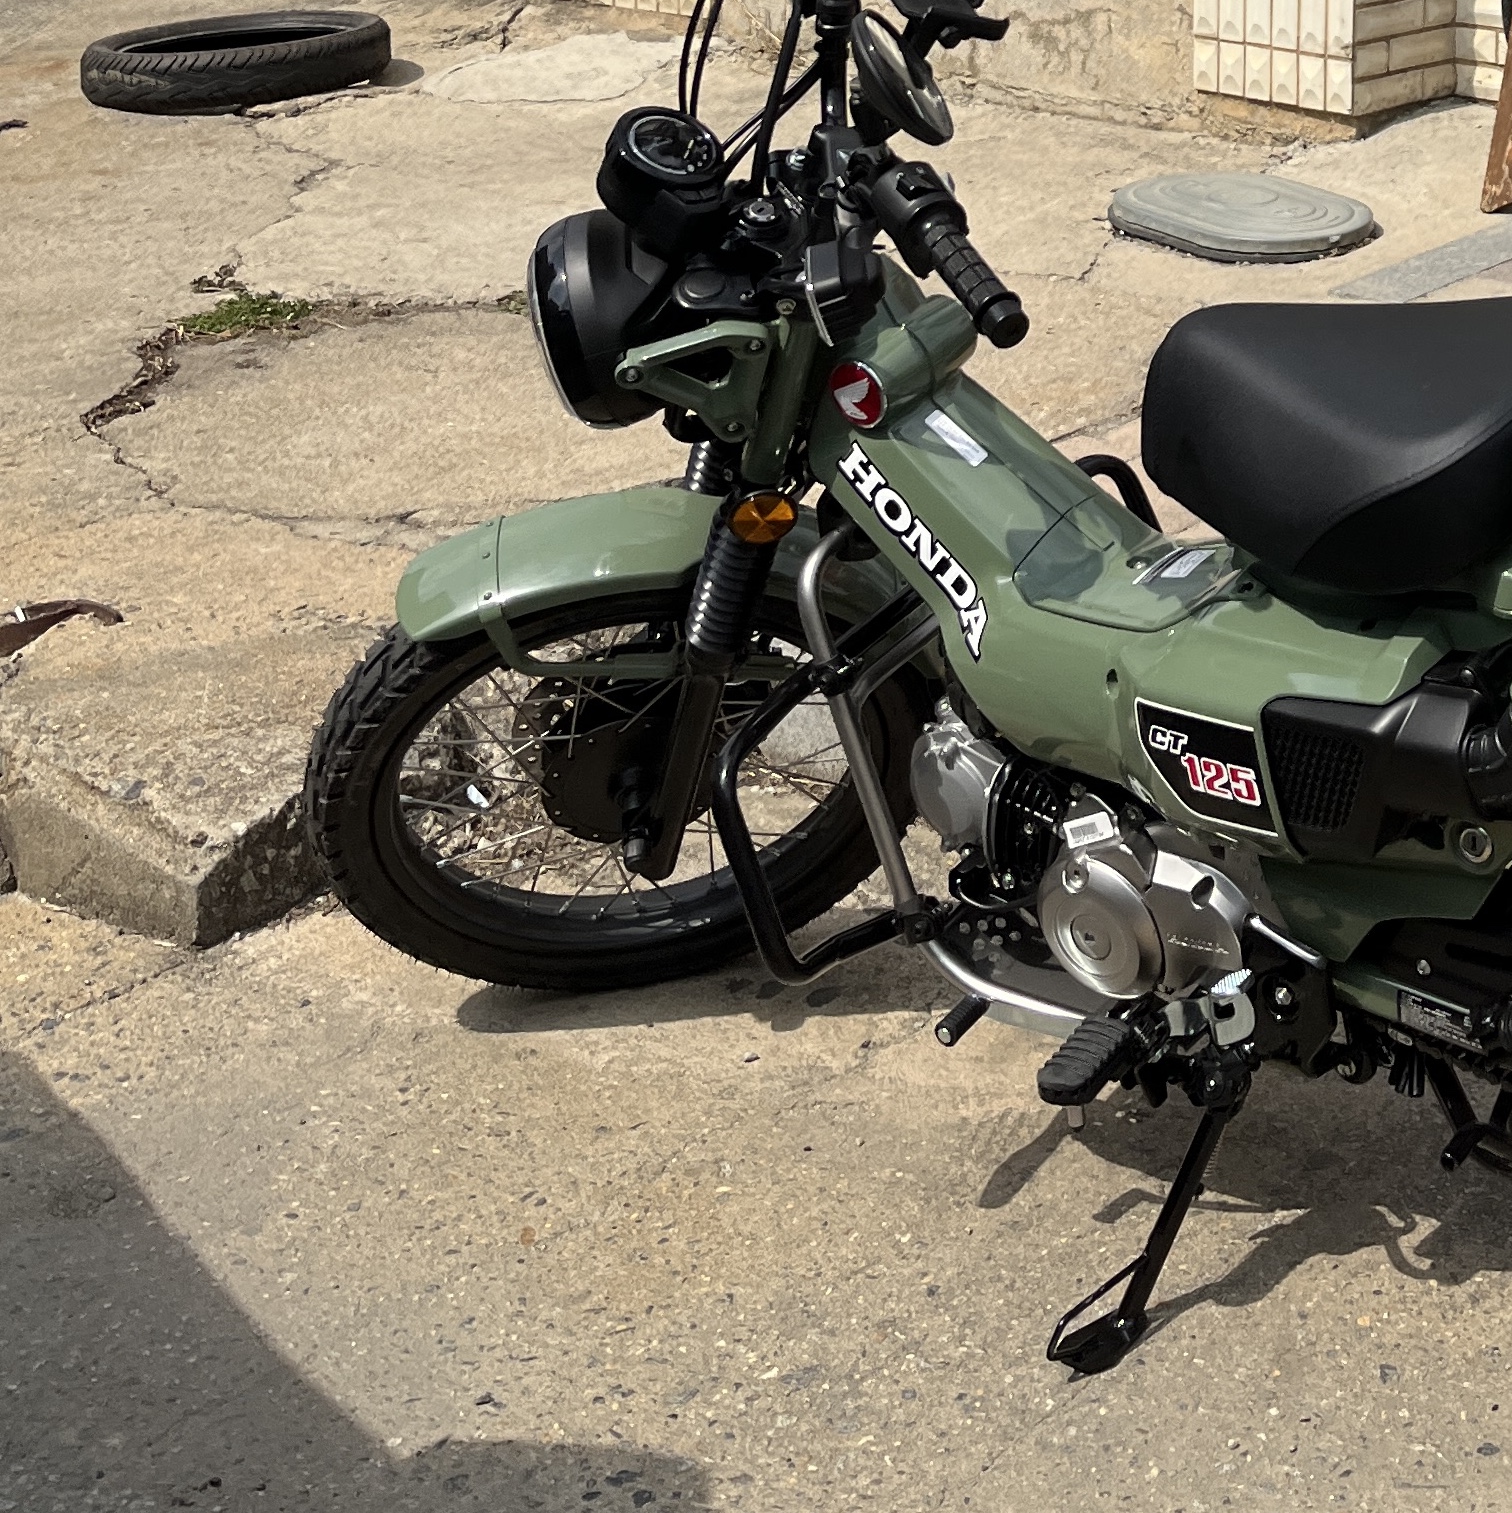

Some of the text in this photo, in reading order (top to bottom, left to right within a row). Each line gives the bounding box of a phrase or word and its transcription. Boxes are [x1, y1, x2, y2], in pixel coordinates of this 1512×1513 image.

[837, 440, 988, 663] HONDA
[1148, 724, 1189, 755] CT
[1180, 752, 1261, 806] 125
